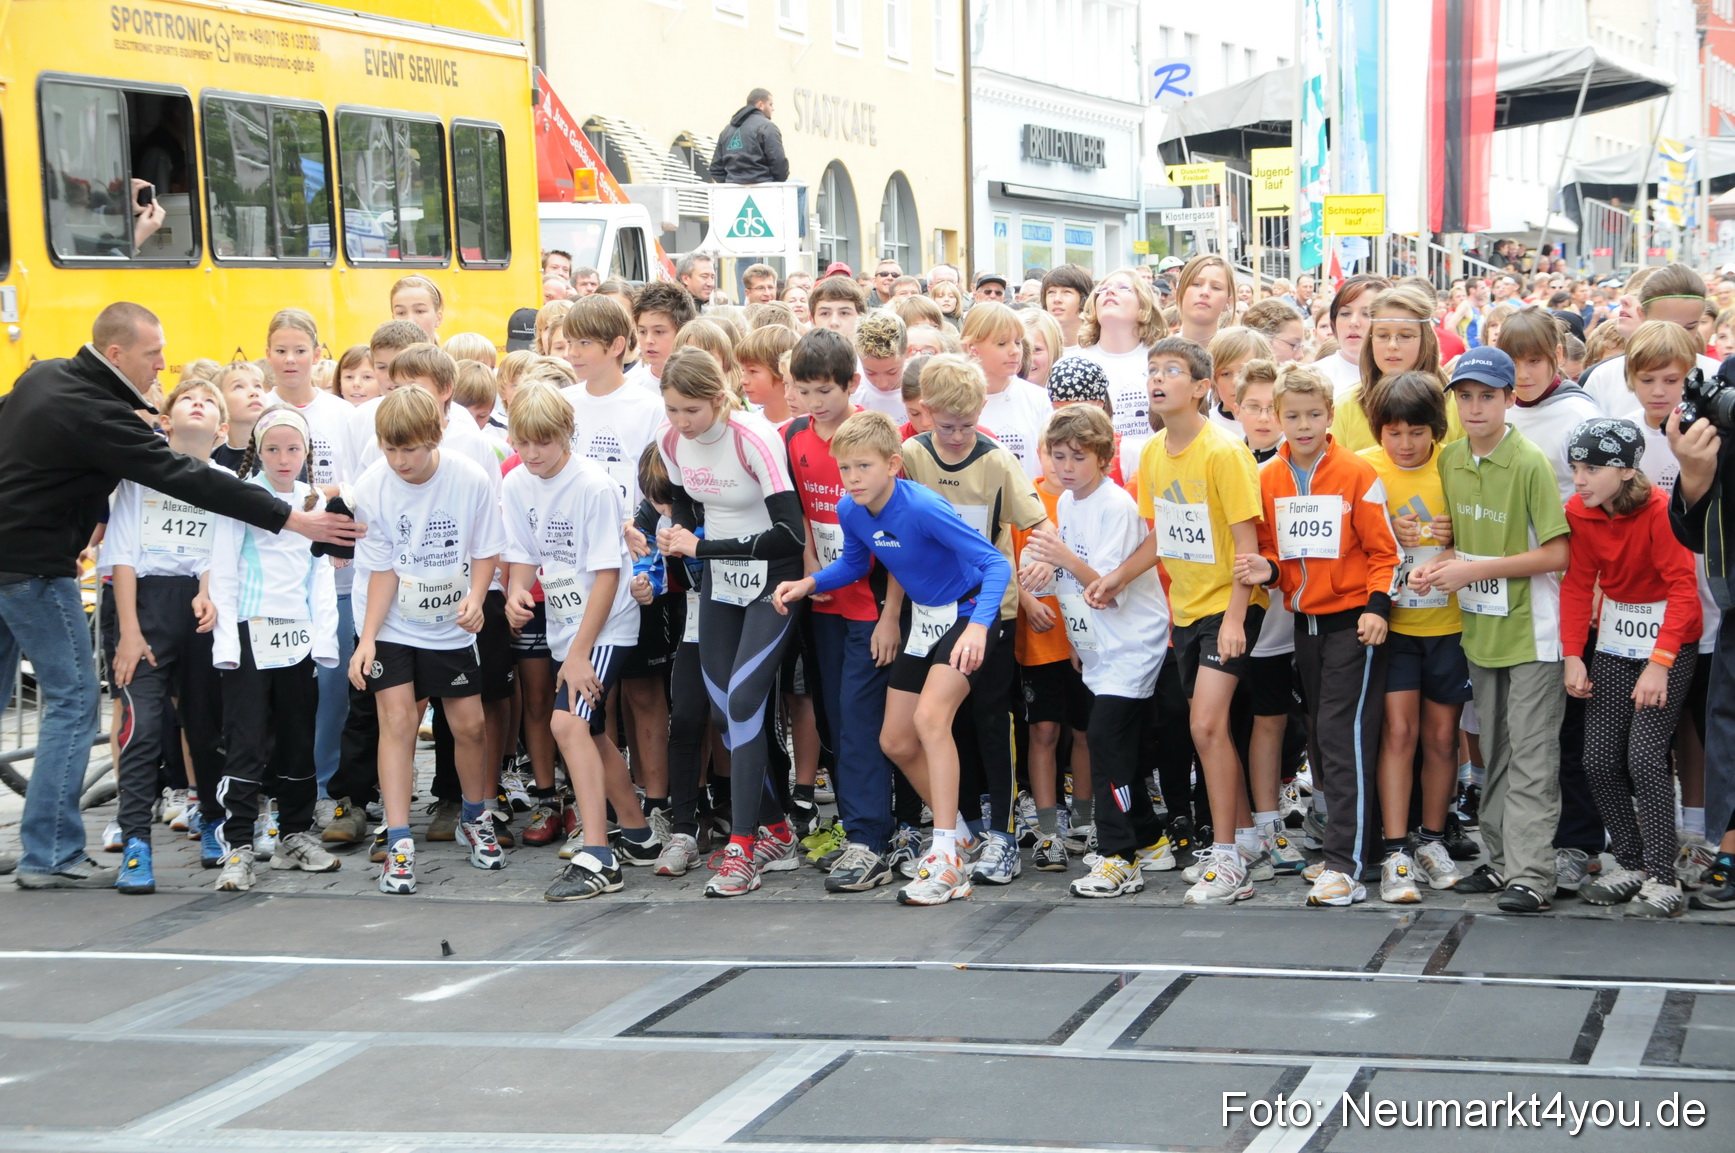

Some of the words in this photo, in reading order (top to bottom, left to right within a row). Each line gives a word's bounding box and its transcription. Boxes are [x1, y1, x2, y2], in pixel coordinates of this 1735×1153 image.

[111, 5, 213, 44] SPORTRONIC
[155, 44, 179, 56] SPORTS
[364, 48, 405, 80] EVENT
[408, 54, 459, 87] SERVICE
[1029, 124, 1070, 163] BRILLEN
[1071, 132, 1106, 169] WEBER
[1254, 165, 1294, 180] Jugend-
[1265, 178, 1282, 190] lauf
[1166, 211, 1215, 222] Klostergasse
[1328, 206, 1380, 218] Schnupper-
[1345, 216, 1362, 226] lauf
[1116, 401, 1148, 409] 21.09.2008
[590, 446, 621, 454] 21.09.2008
[938, 478, 960, 487] JAKO
[1289, 502, 1319, 514] Florian
[162, 518, 208, 538] 4127
[1289, 520, 1333, 538] 4095
[424, 529, 459, 541] 21.09.2008
[1169, 525, 1206, 544] 4134
[874, 540, 901, 548] skinfit
[413, 550, 459, 563] Neumarkter
[424, 556, 459, 568] Stadtlauf
[724, 572, 761, 589] 4104
[418, 582, 453, 593] Thomas
[419, 590, 462, 610] 4040
[1614, 601, 1652, 614] Vanessa
[1615, 618, 1660, 639] 4000
[270, 629, 310, 649] 4106
